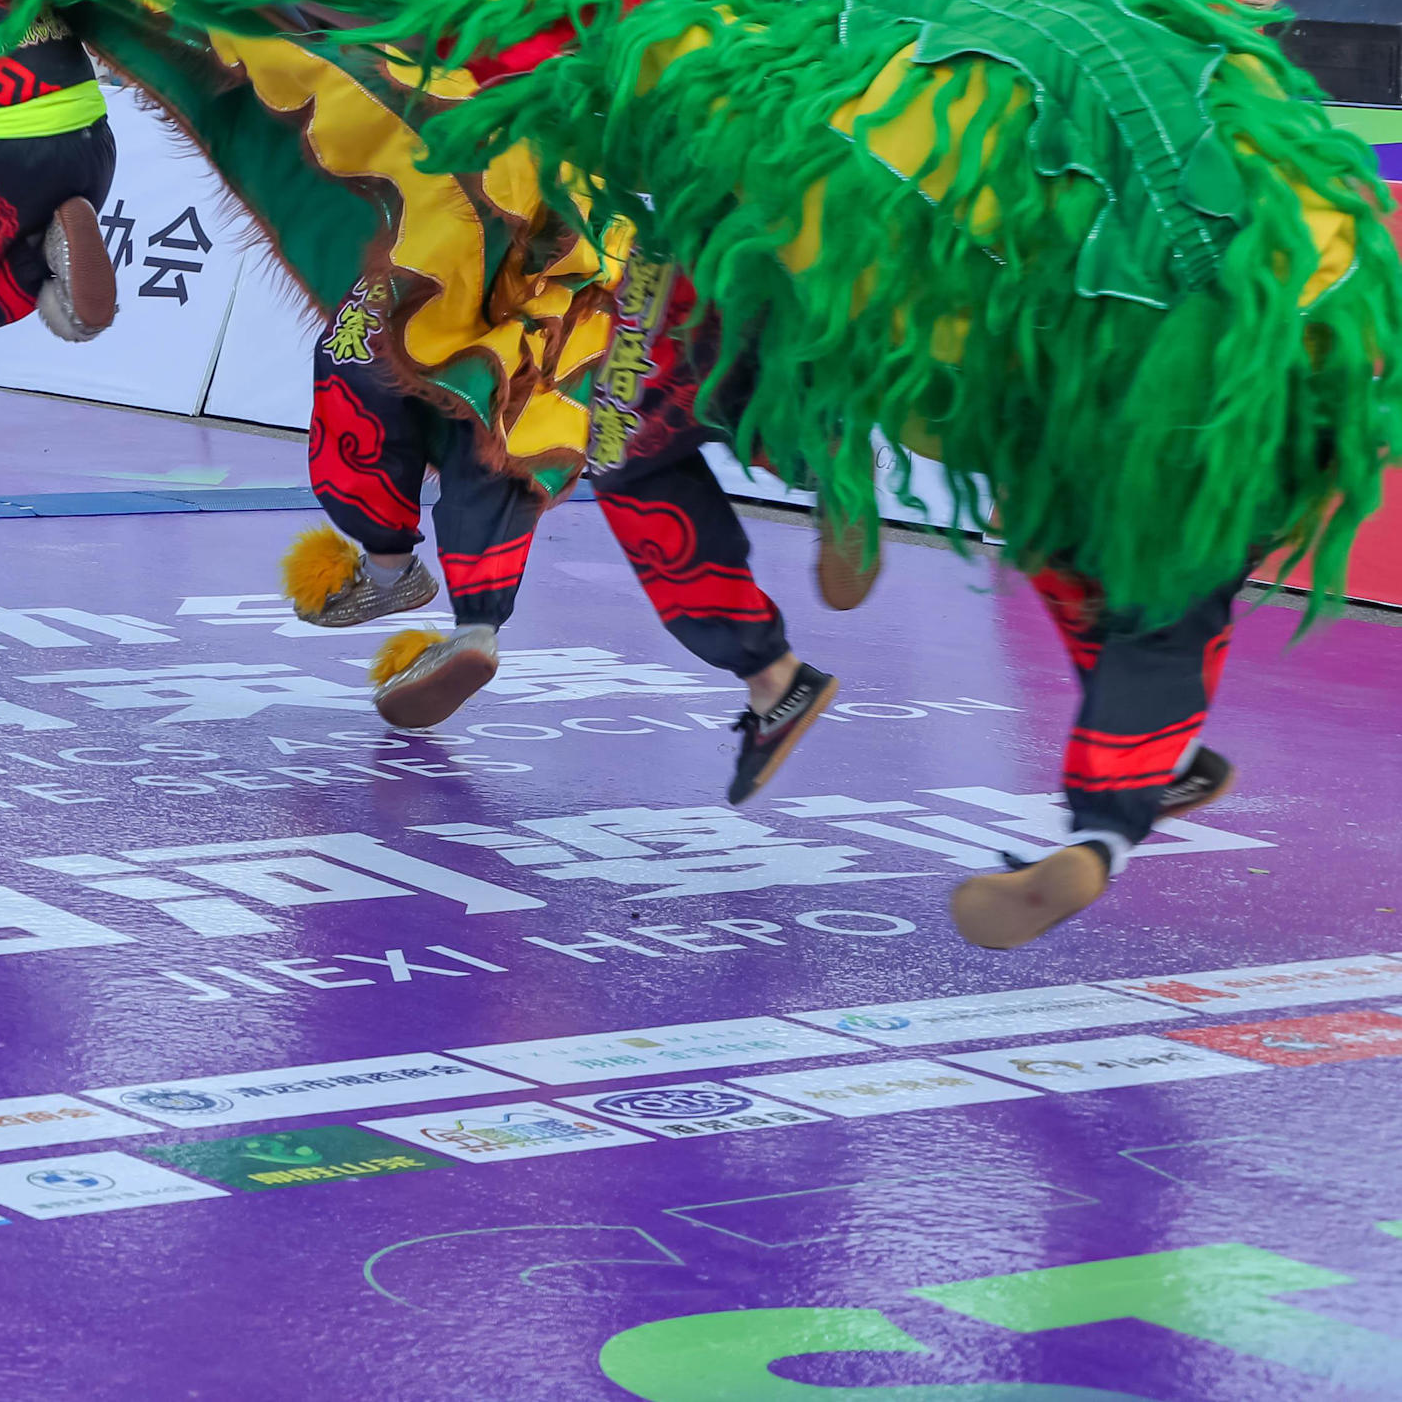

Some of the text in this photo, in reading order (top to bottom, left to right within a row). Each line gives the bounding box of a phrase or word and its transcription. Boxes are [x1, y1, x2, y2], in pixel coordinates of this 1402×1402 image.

[132, 750, 530, 797] SERIES
[162, 908, 916, 1000] JIEXI HEPO
[226, 1064, 472, 1098] 清远市揭西商会
